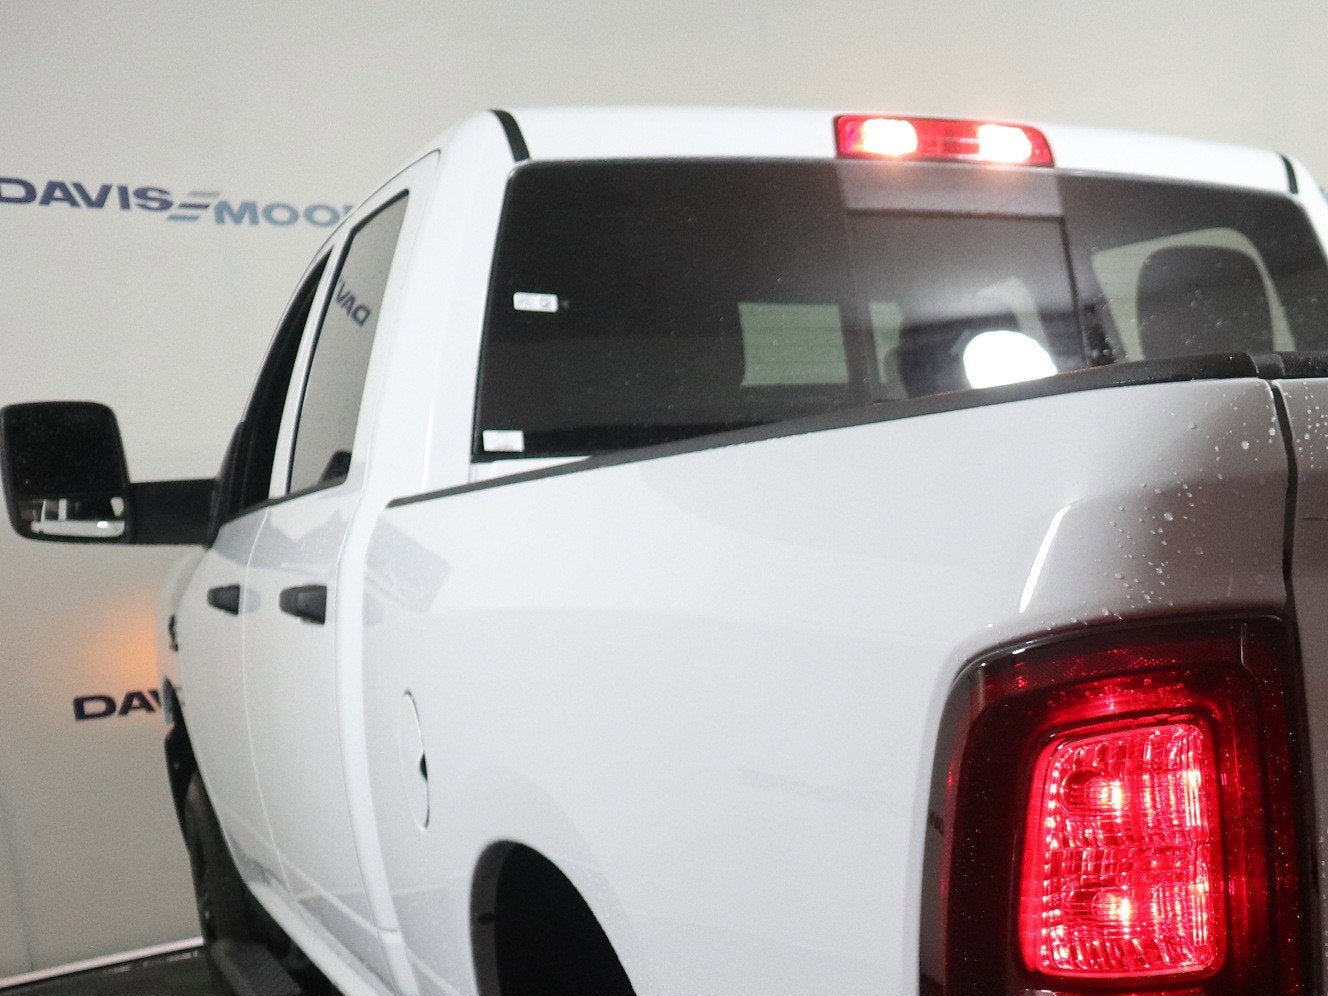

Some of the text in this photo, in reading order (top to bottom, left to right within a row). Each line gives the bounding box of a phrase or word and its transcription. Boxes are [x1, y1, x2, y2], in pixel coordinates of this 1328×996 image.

[0, 177, 353, 227] DAVIS MOO
[73, 690, 161, 721] DA
